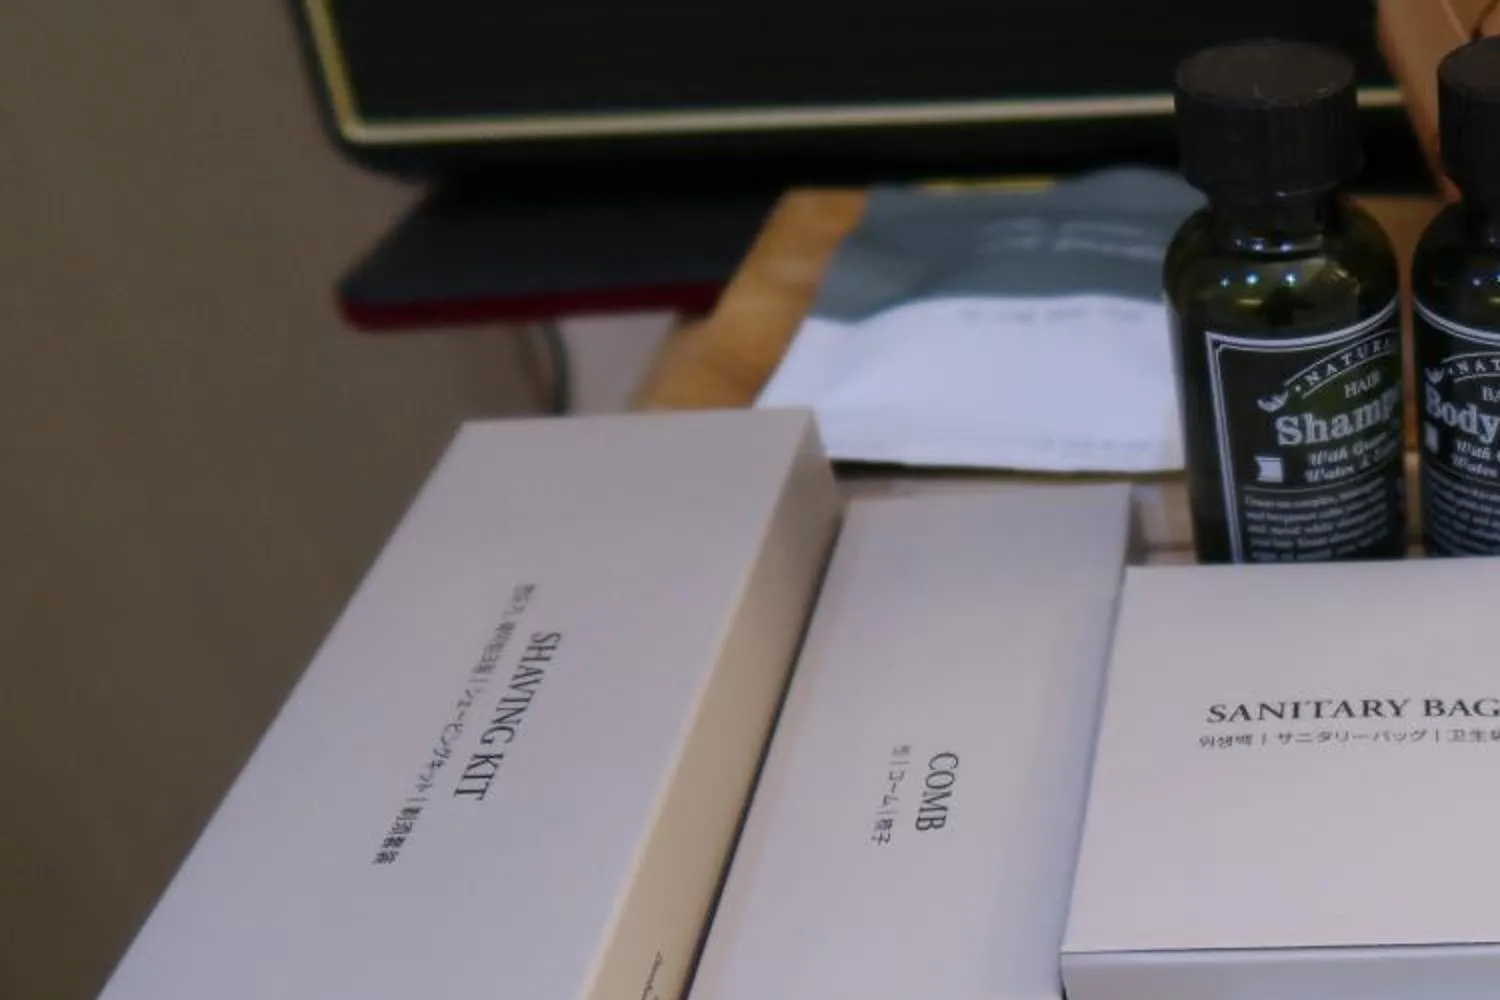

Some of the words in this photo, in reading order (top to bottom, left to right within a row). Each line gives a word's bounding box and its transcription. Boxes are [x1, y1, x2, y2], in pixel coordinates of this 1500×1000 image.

[1305, 336, 1394, 386] NATURA
[1275, 386, 1399, 446] Shamp
[479, 631, 562, 747] SHAVING
[1204, 699, 1412, 724] SANITARY
[453, 752, 505, 801] KIT
[915, 751, 960, 832] COMB
